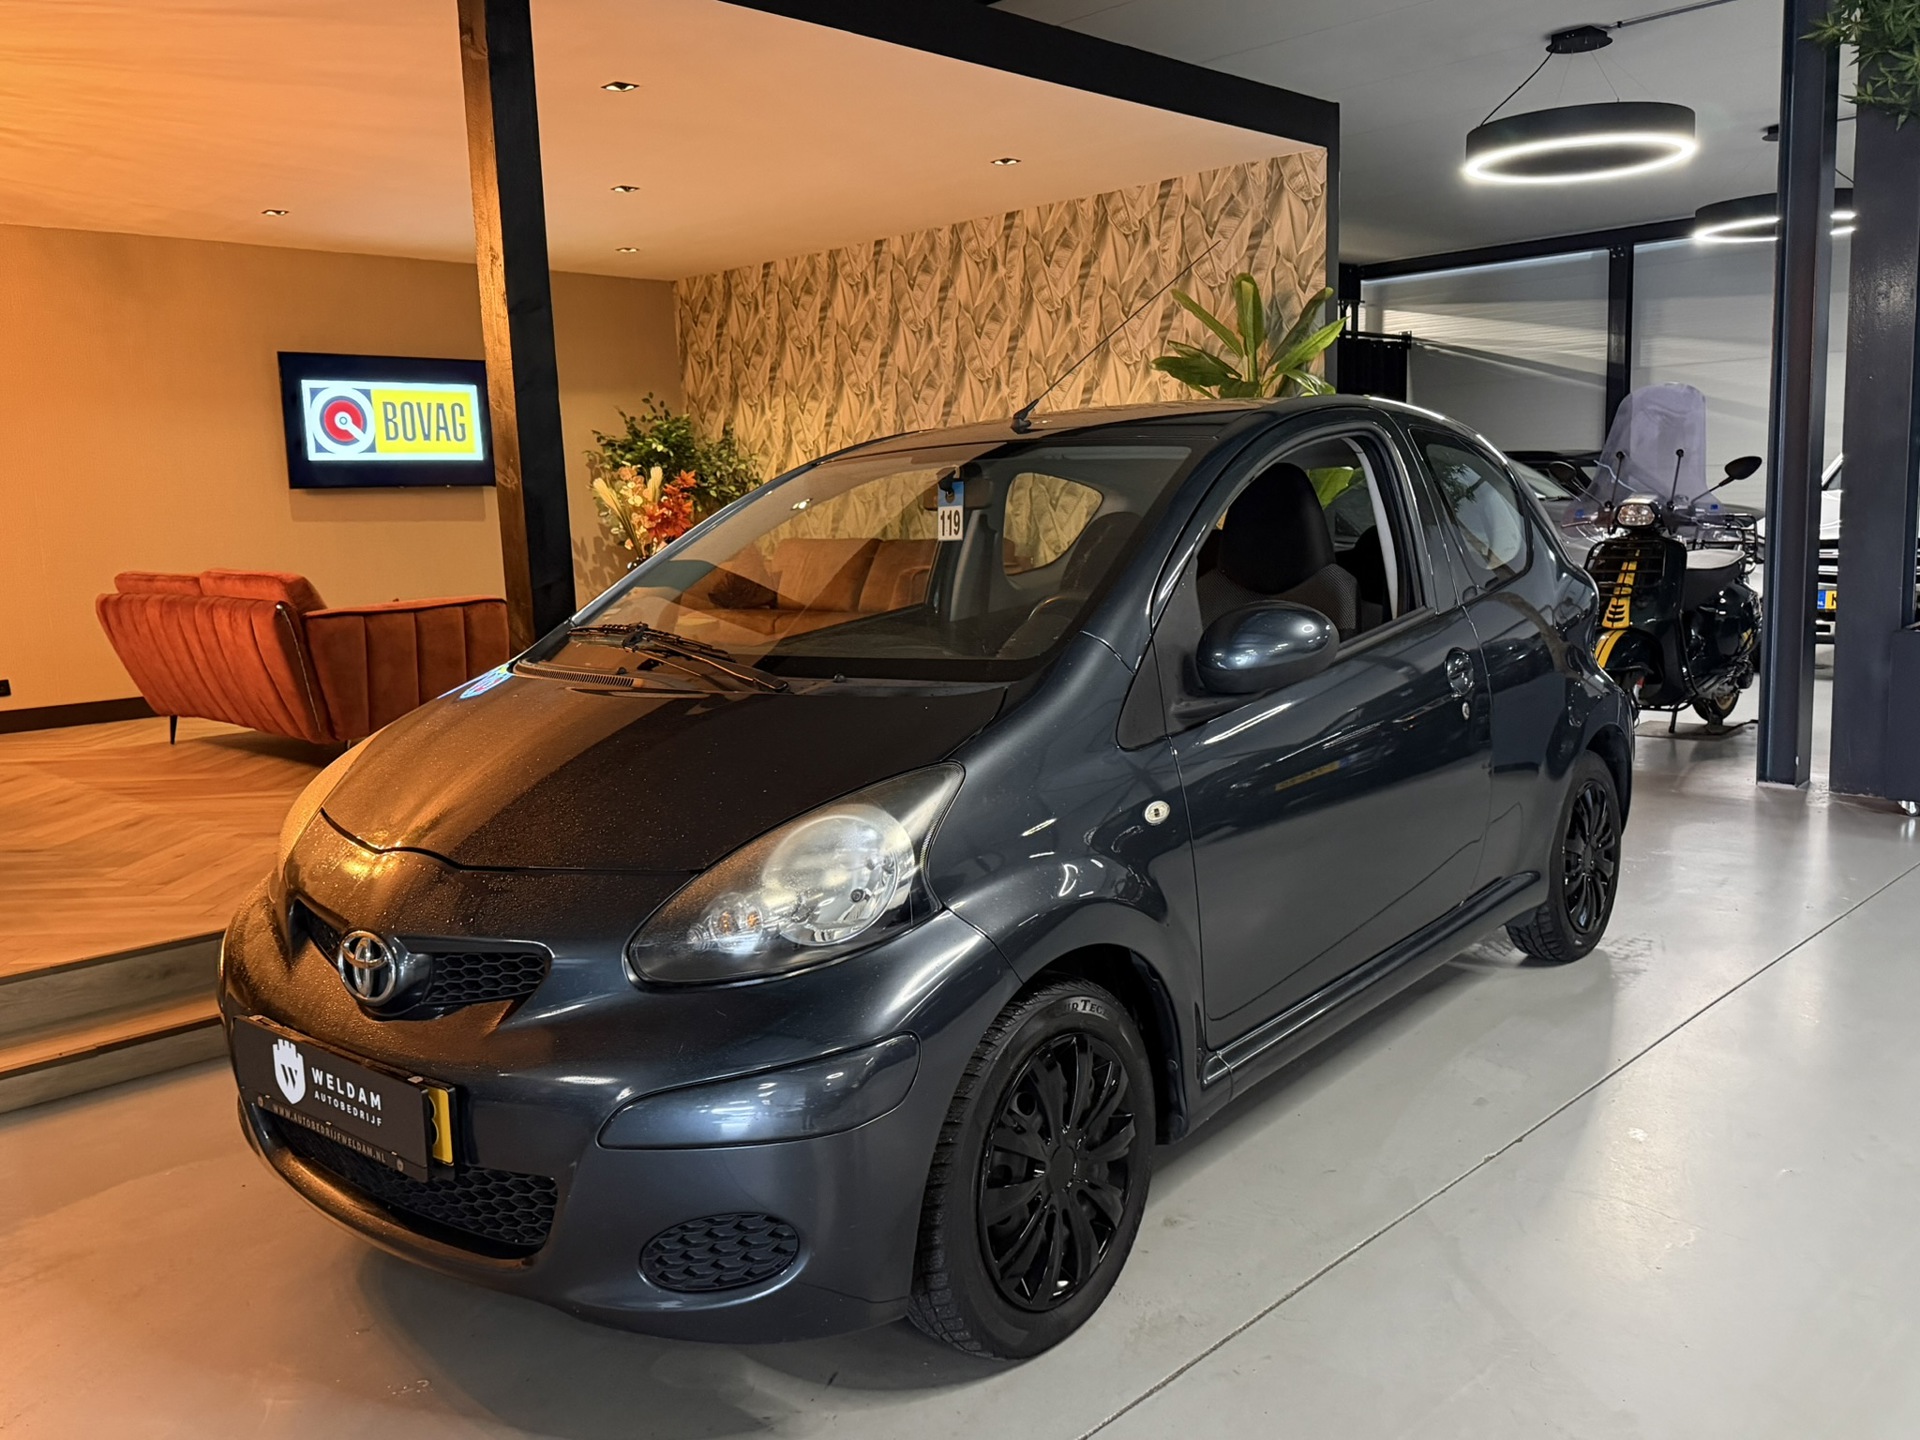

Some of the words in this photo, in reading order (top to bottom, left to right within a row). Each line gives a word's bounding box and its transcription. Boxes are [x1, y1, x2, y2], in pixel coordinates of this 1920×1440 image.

[382, 401, 467, 442] BOVAG
[940, 509, 960, 537] 119
[311, 1066, 382, 1111] WELDAM
[314, 1090, 382, 1128] AUTOBEDRIJF
[272, 1103, 387, 1164] WWW.AUTOBEDRIJFWELDAM.NL
